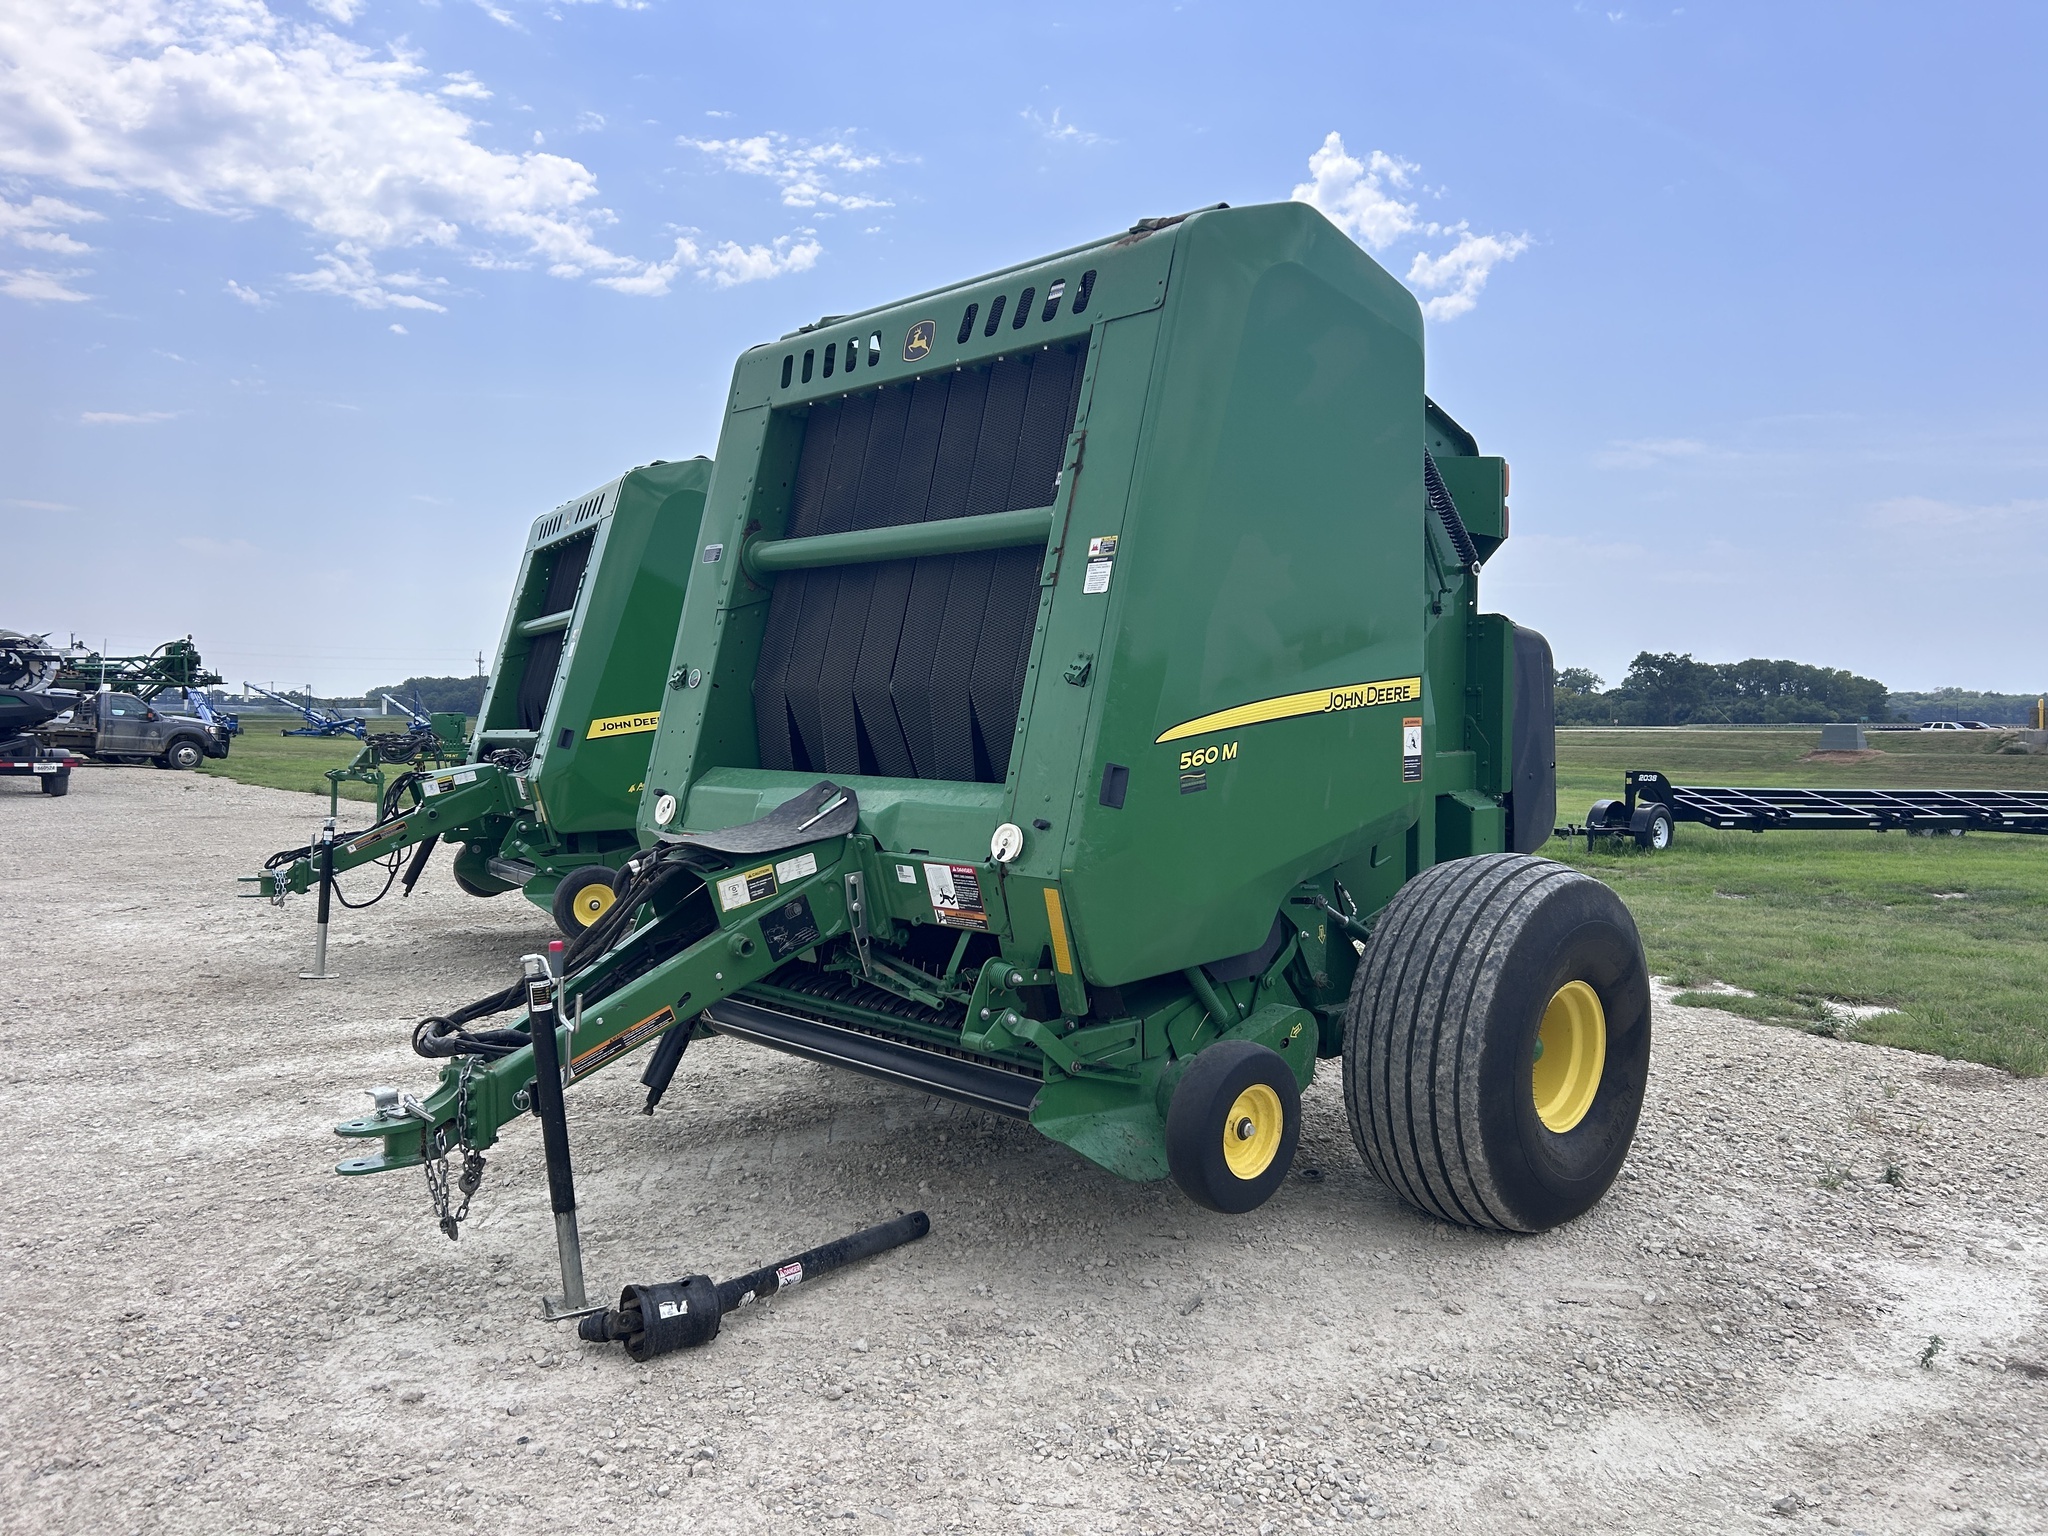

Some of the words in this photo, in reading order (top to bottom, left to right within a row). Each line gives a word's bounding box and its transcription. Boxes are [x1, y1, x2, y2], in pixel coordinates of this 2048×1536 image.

[1325, 691, 1364, 710] JOHN
[1367, 686, 1411, 704] DEERE
[600, 720, 632, 731] JOHN
[633, 717, 660, 727] DEE
[1179, 745, 1220, 770] 560
[1221, 741, 1239, 761] M
[752, 868, 770, 876] CAUTION
[784, 1265, 801, 1276] DANGER
